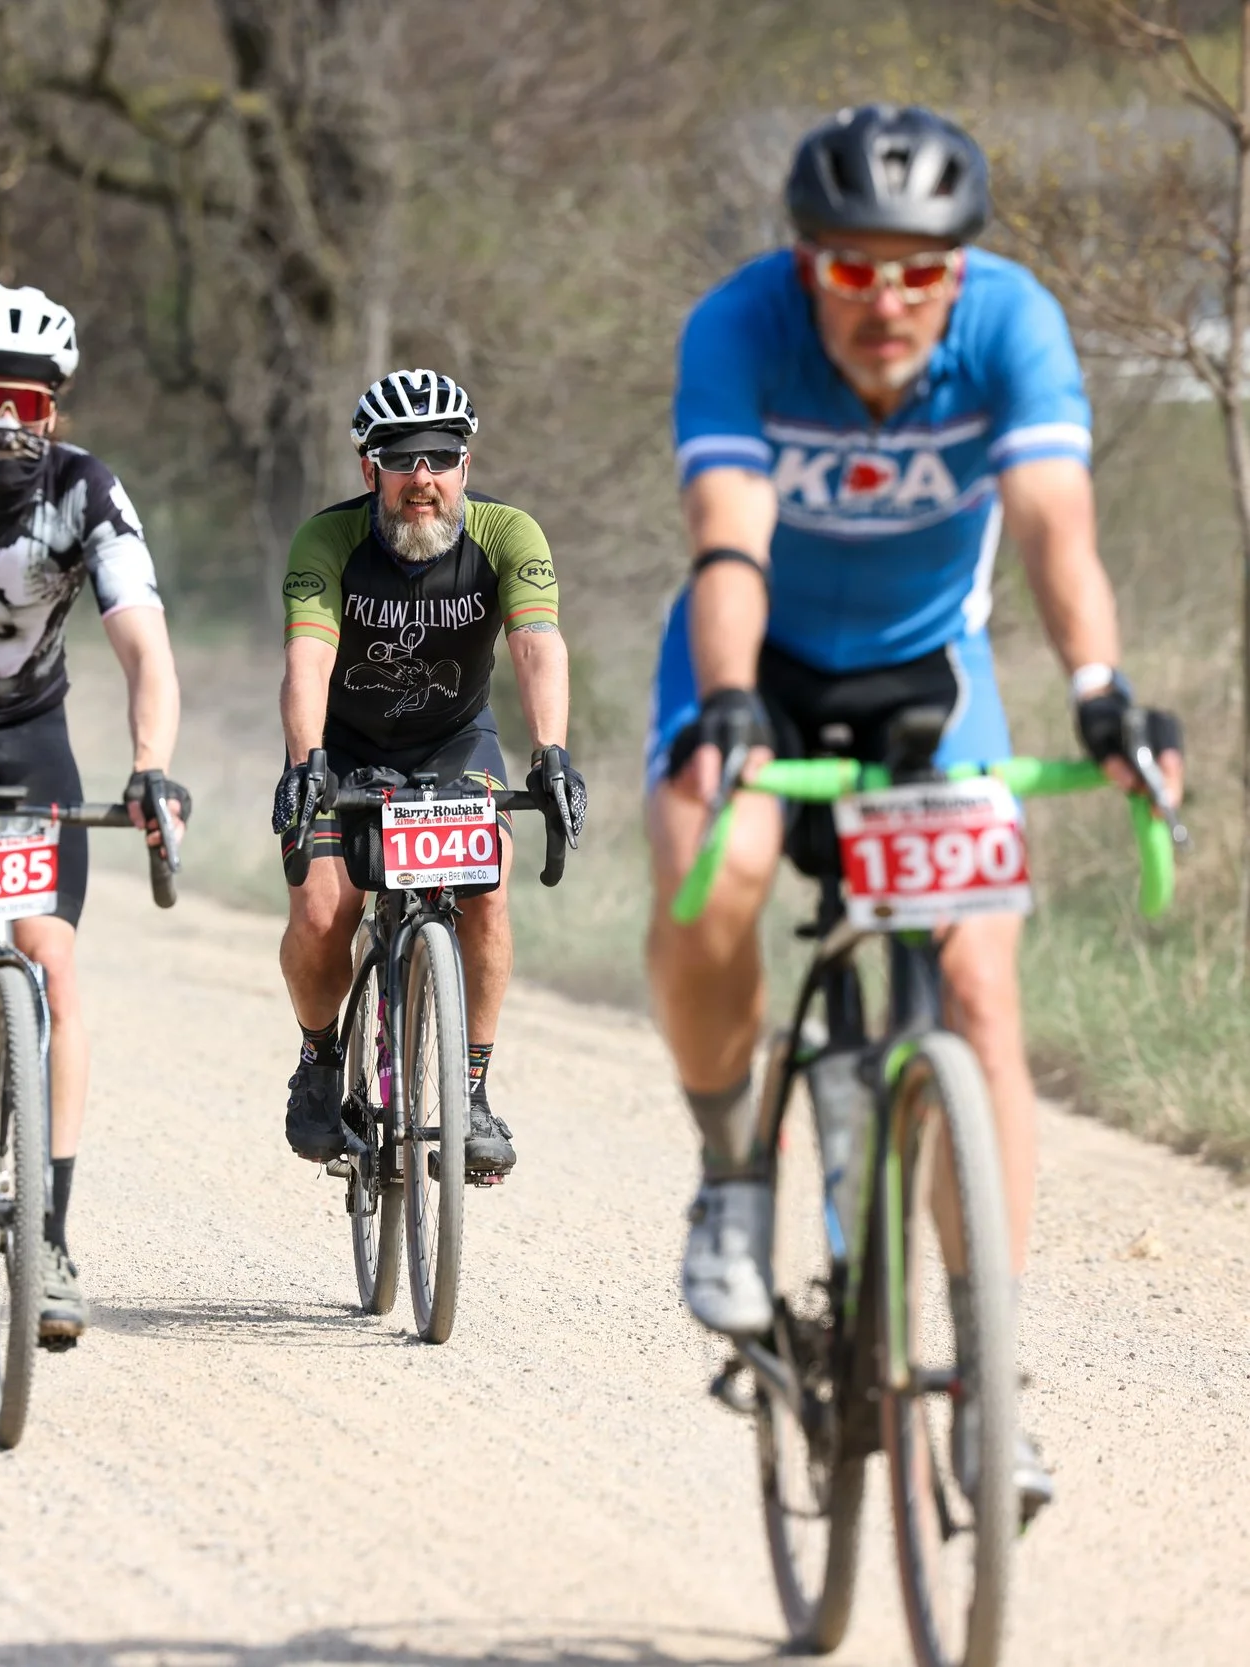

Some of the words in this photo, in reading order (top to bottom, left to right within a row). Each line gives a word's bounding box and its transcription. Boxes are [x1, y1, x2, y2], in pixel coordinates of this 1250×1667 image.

[414, 592, 486, 631] ILLINOIS
[393, 803, 484, 819] Barry-Roubaix
[390, 828, 494, 866] 1040
[852, 827, 1022, 892] 1390
